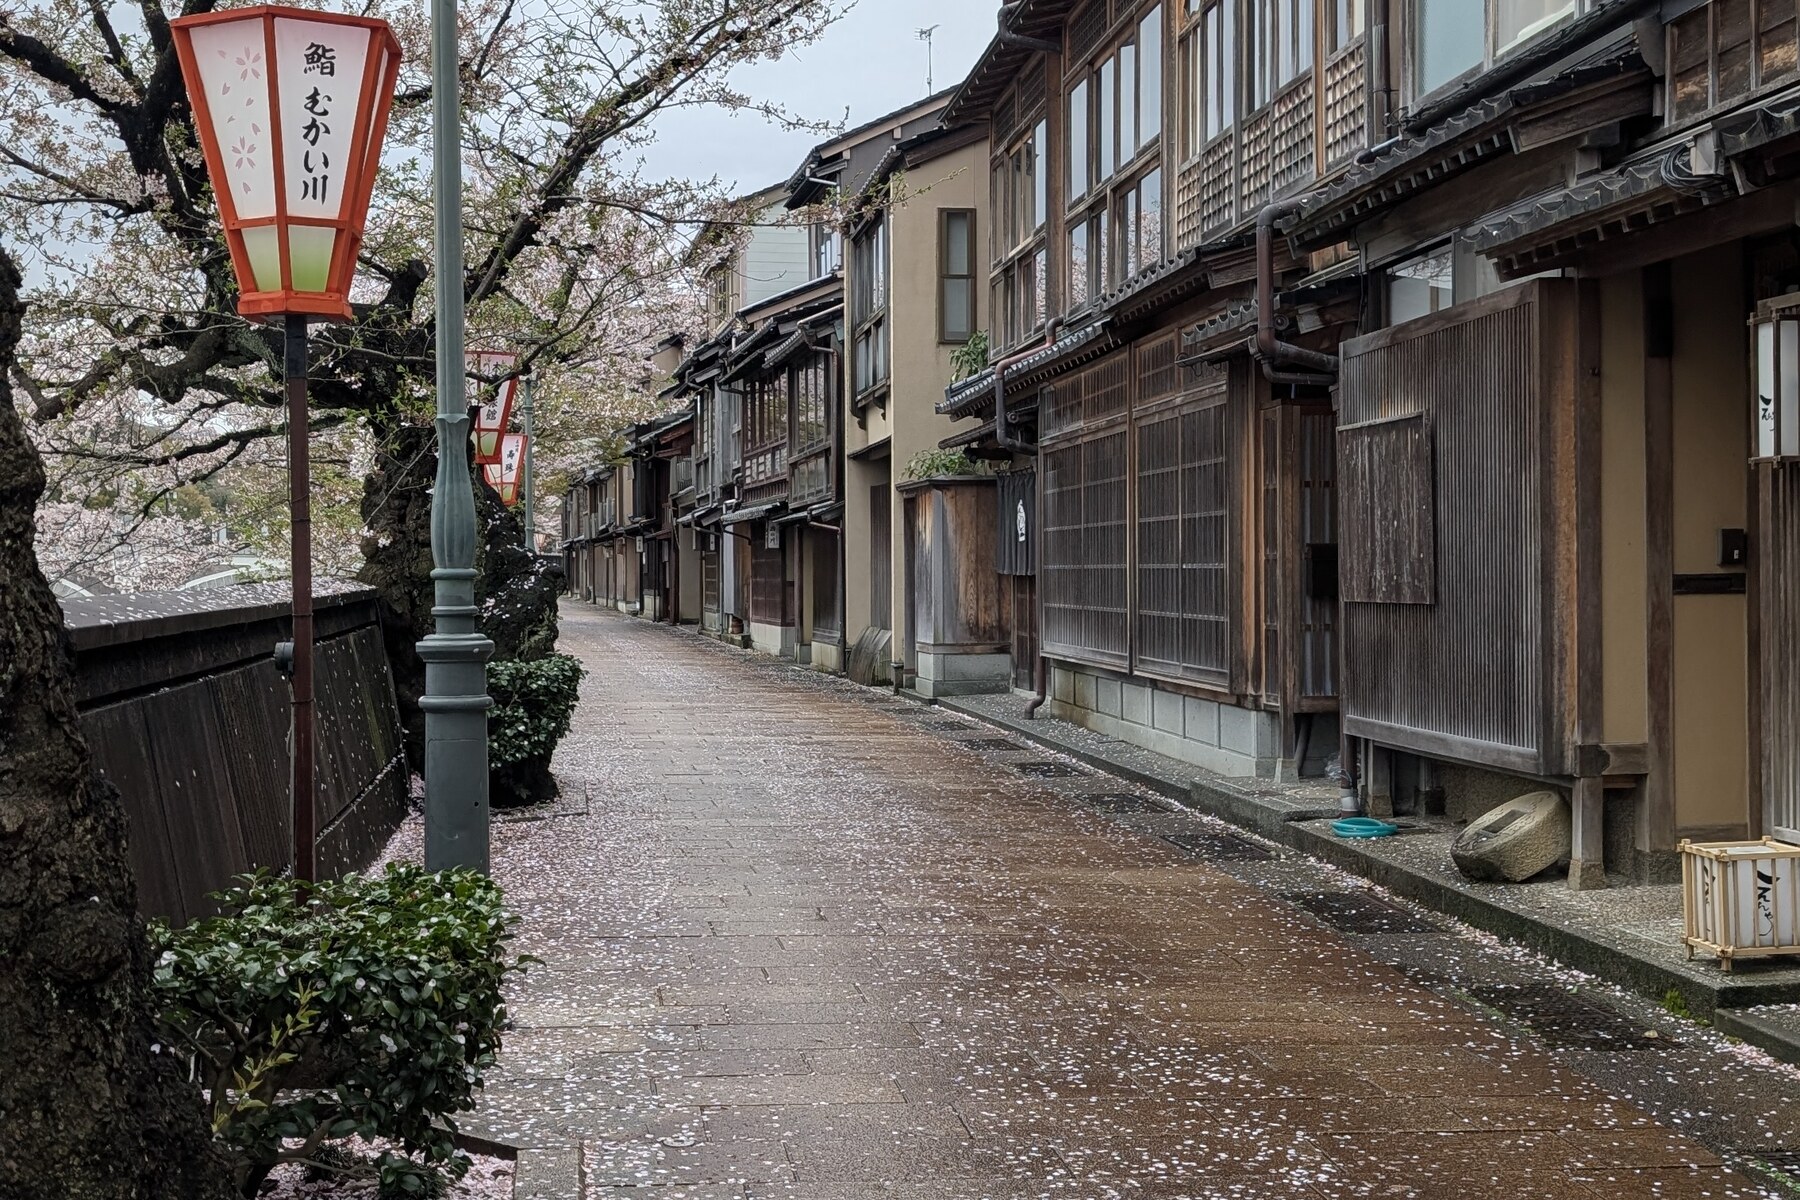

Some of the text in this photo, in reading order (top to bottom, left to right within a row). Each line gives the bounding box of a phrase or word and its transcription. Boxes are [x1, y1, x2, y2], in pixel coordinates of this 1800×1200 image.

[300, 41, 336, 206] 鮨 むかい川
